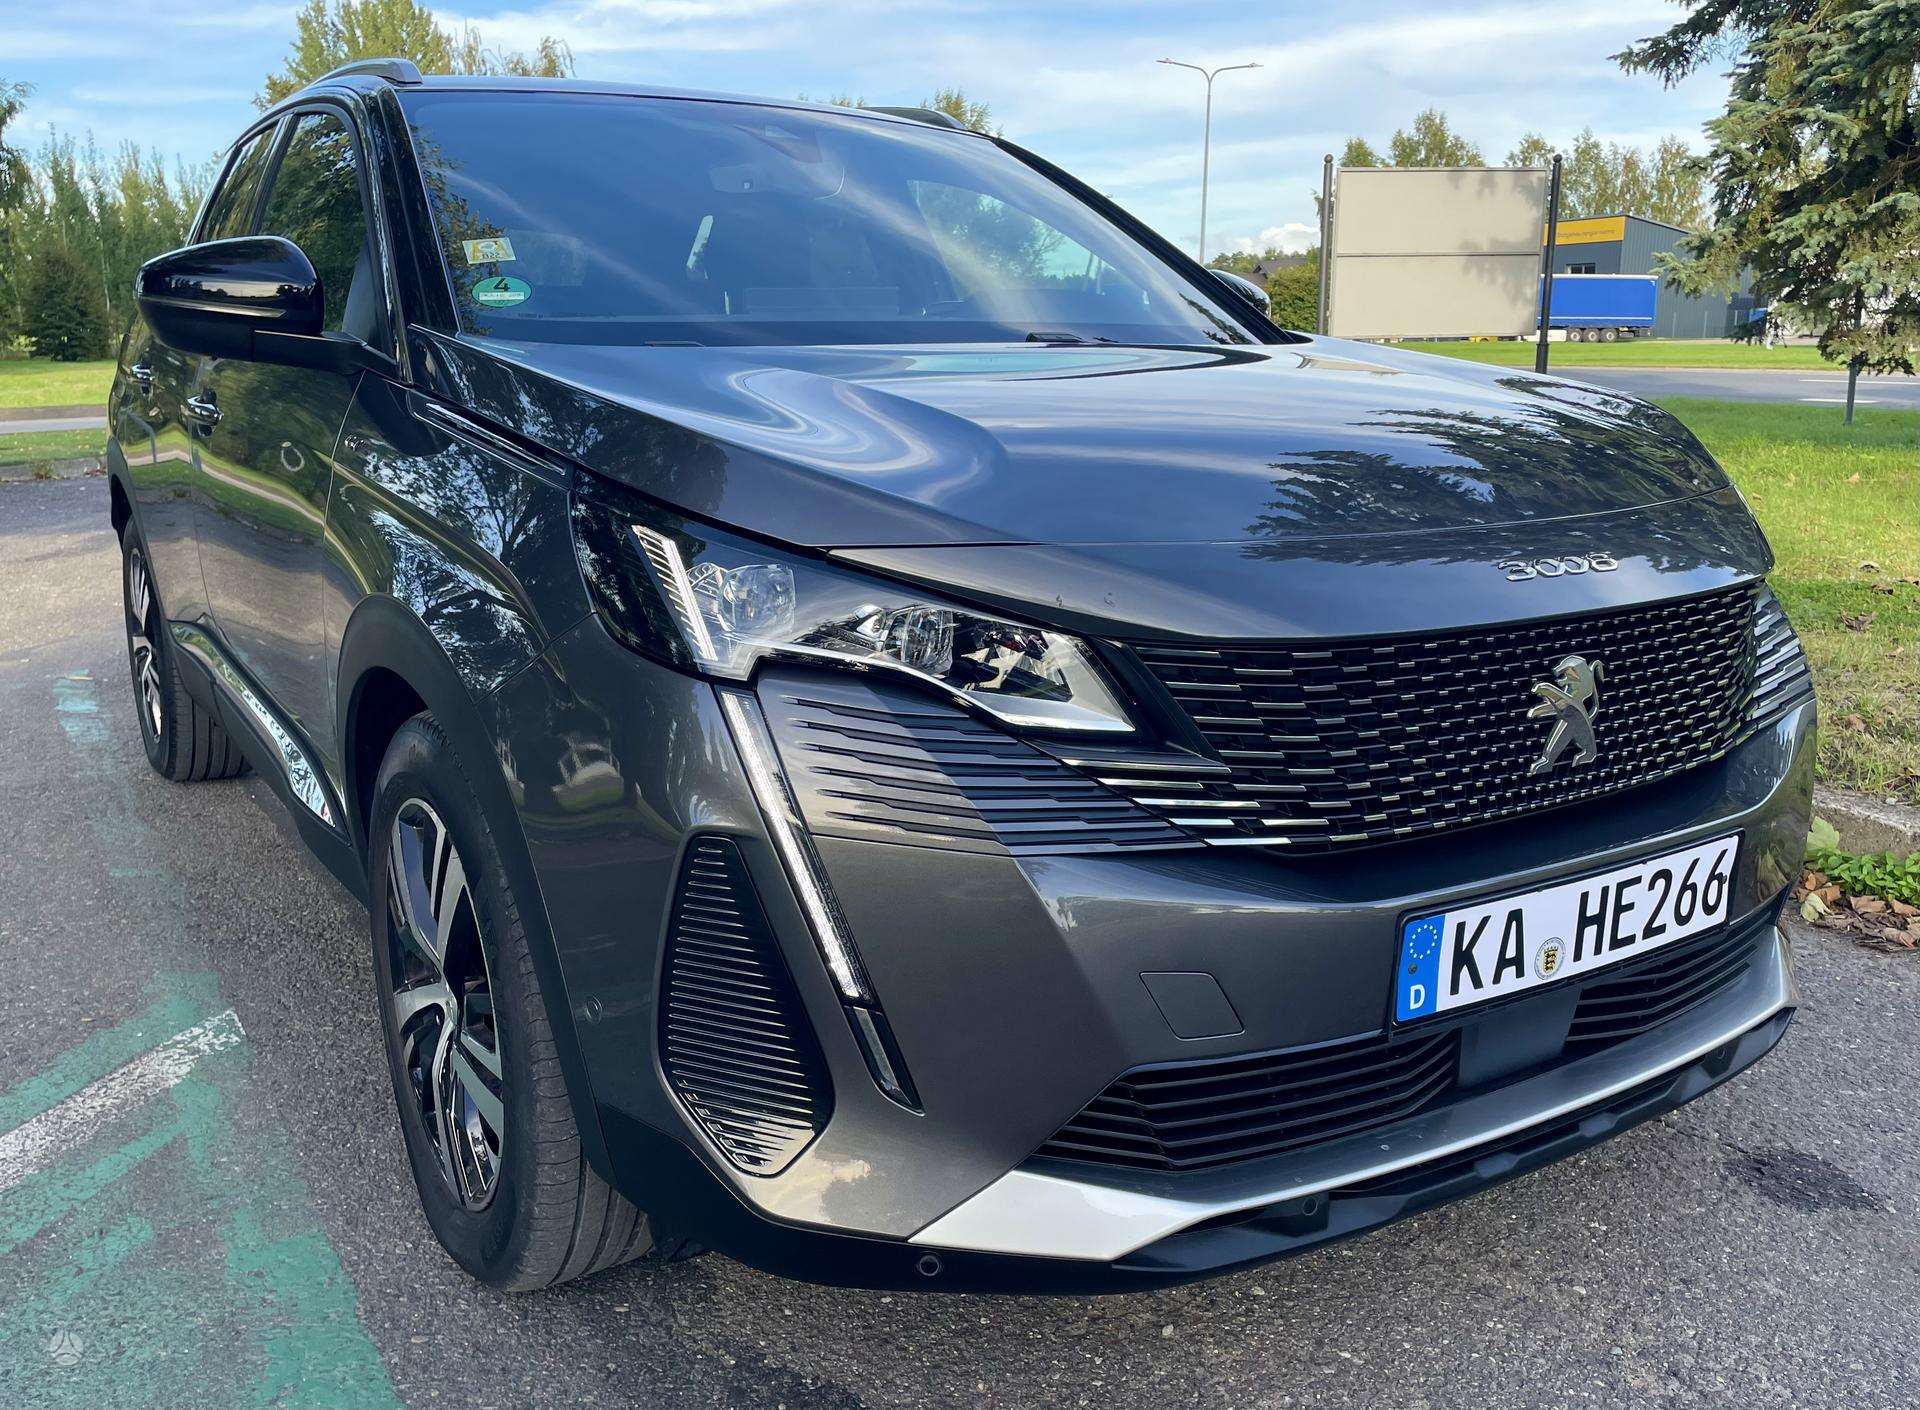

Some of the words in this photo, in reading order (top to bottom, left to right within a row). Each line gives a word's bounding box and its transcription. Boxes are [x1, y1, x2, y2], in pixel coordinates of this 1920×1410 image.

[493, 277, 511, 292] 4
[1498, 551, 1619, 582] 3008
[1450, 908, 1526, 996] KA
[1573, 848, 1729, 963] HE266
[1410, 984, 1426, 1010] D
